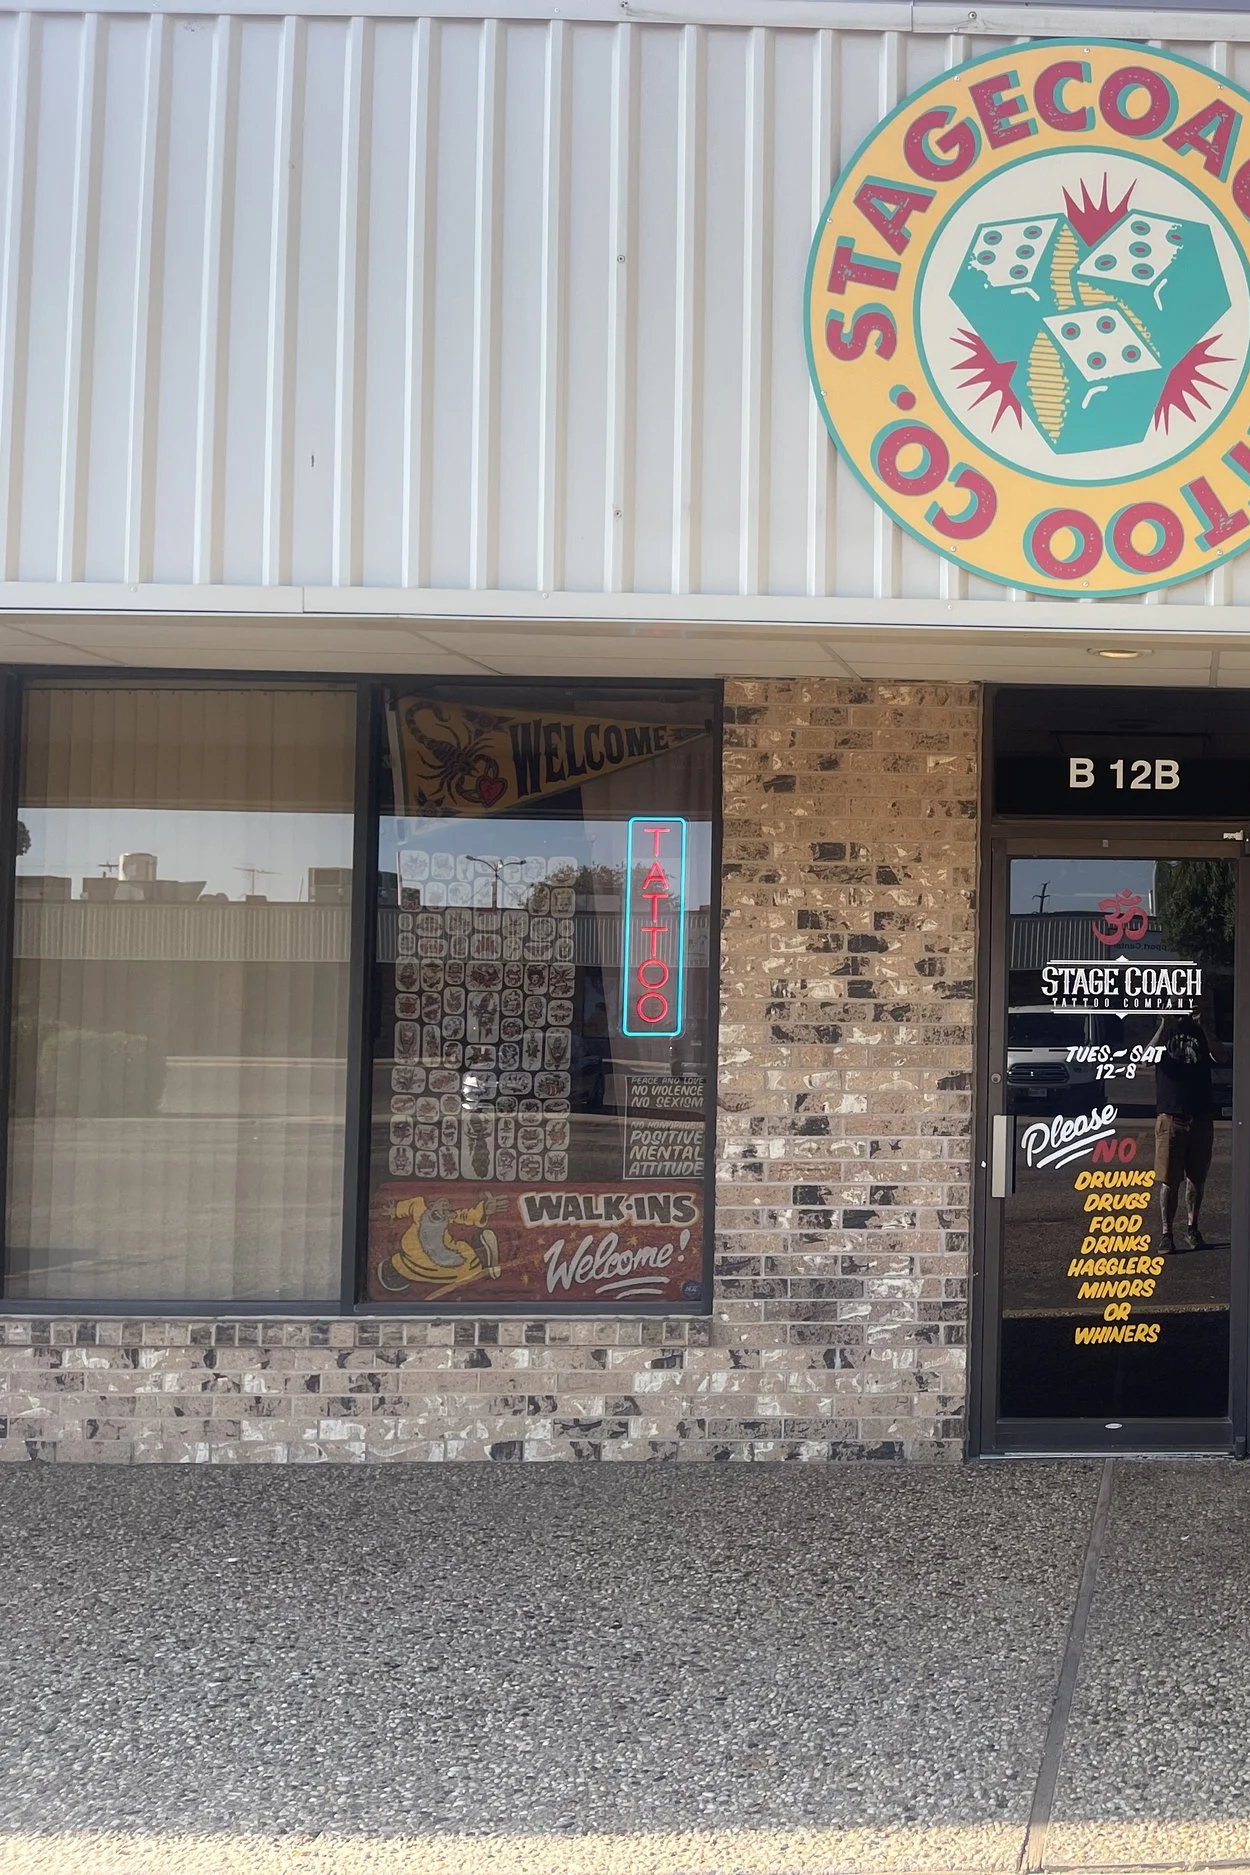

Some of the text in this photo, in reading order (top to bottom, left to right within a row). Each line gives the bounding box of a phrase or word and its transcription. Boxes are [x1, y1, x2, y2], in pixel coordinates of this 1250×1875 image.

[870, 384, 997, 541] CO.
[509, 719, 671, 797] WELCOME
[1069, 757, 1180, 790] B 12B
[637, 828, 671, 1023] TATTOO
[1041, 966, 1202, 996] STAGE COACH
[1053, 998, 1194, 1009] TATTOO COMPANY
[1130, 1045, 1167, 1063] SAT
[1095, 1063, 1137, 1080] 12-8
[631, 1085, 705, 1096] NO VIOLENCE
[631, 1097, 705, 1108] NO SEXISM
[630, 1130, 705, 1145] POSITIVE
[1021, 1104, 1118, 1167] Please
[629, 1146, 705, 1161] MENTAL
[1091, 1138, 1137, 1164] NO
[629, 1161, 705, 1176] ATTITUDE
[1074, 1170, 1157, 1191] DRUNKS
[1083, 1192, 1151, 1212] DRUGS
[1088, 1214, 1143, 1233] FOOD
[1080, 1234, 1151, 1254] DRINKS
[544, 1230, 691, 1293] Welcome!
[1067, 1256, 1165, 1277] HAGGLERS
[1077, 1279, 1156, 1299] MINORS
[1103, 1302, 1132, 1321] OR
[1074, 1323, 1161, 1345] WHINERS
